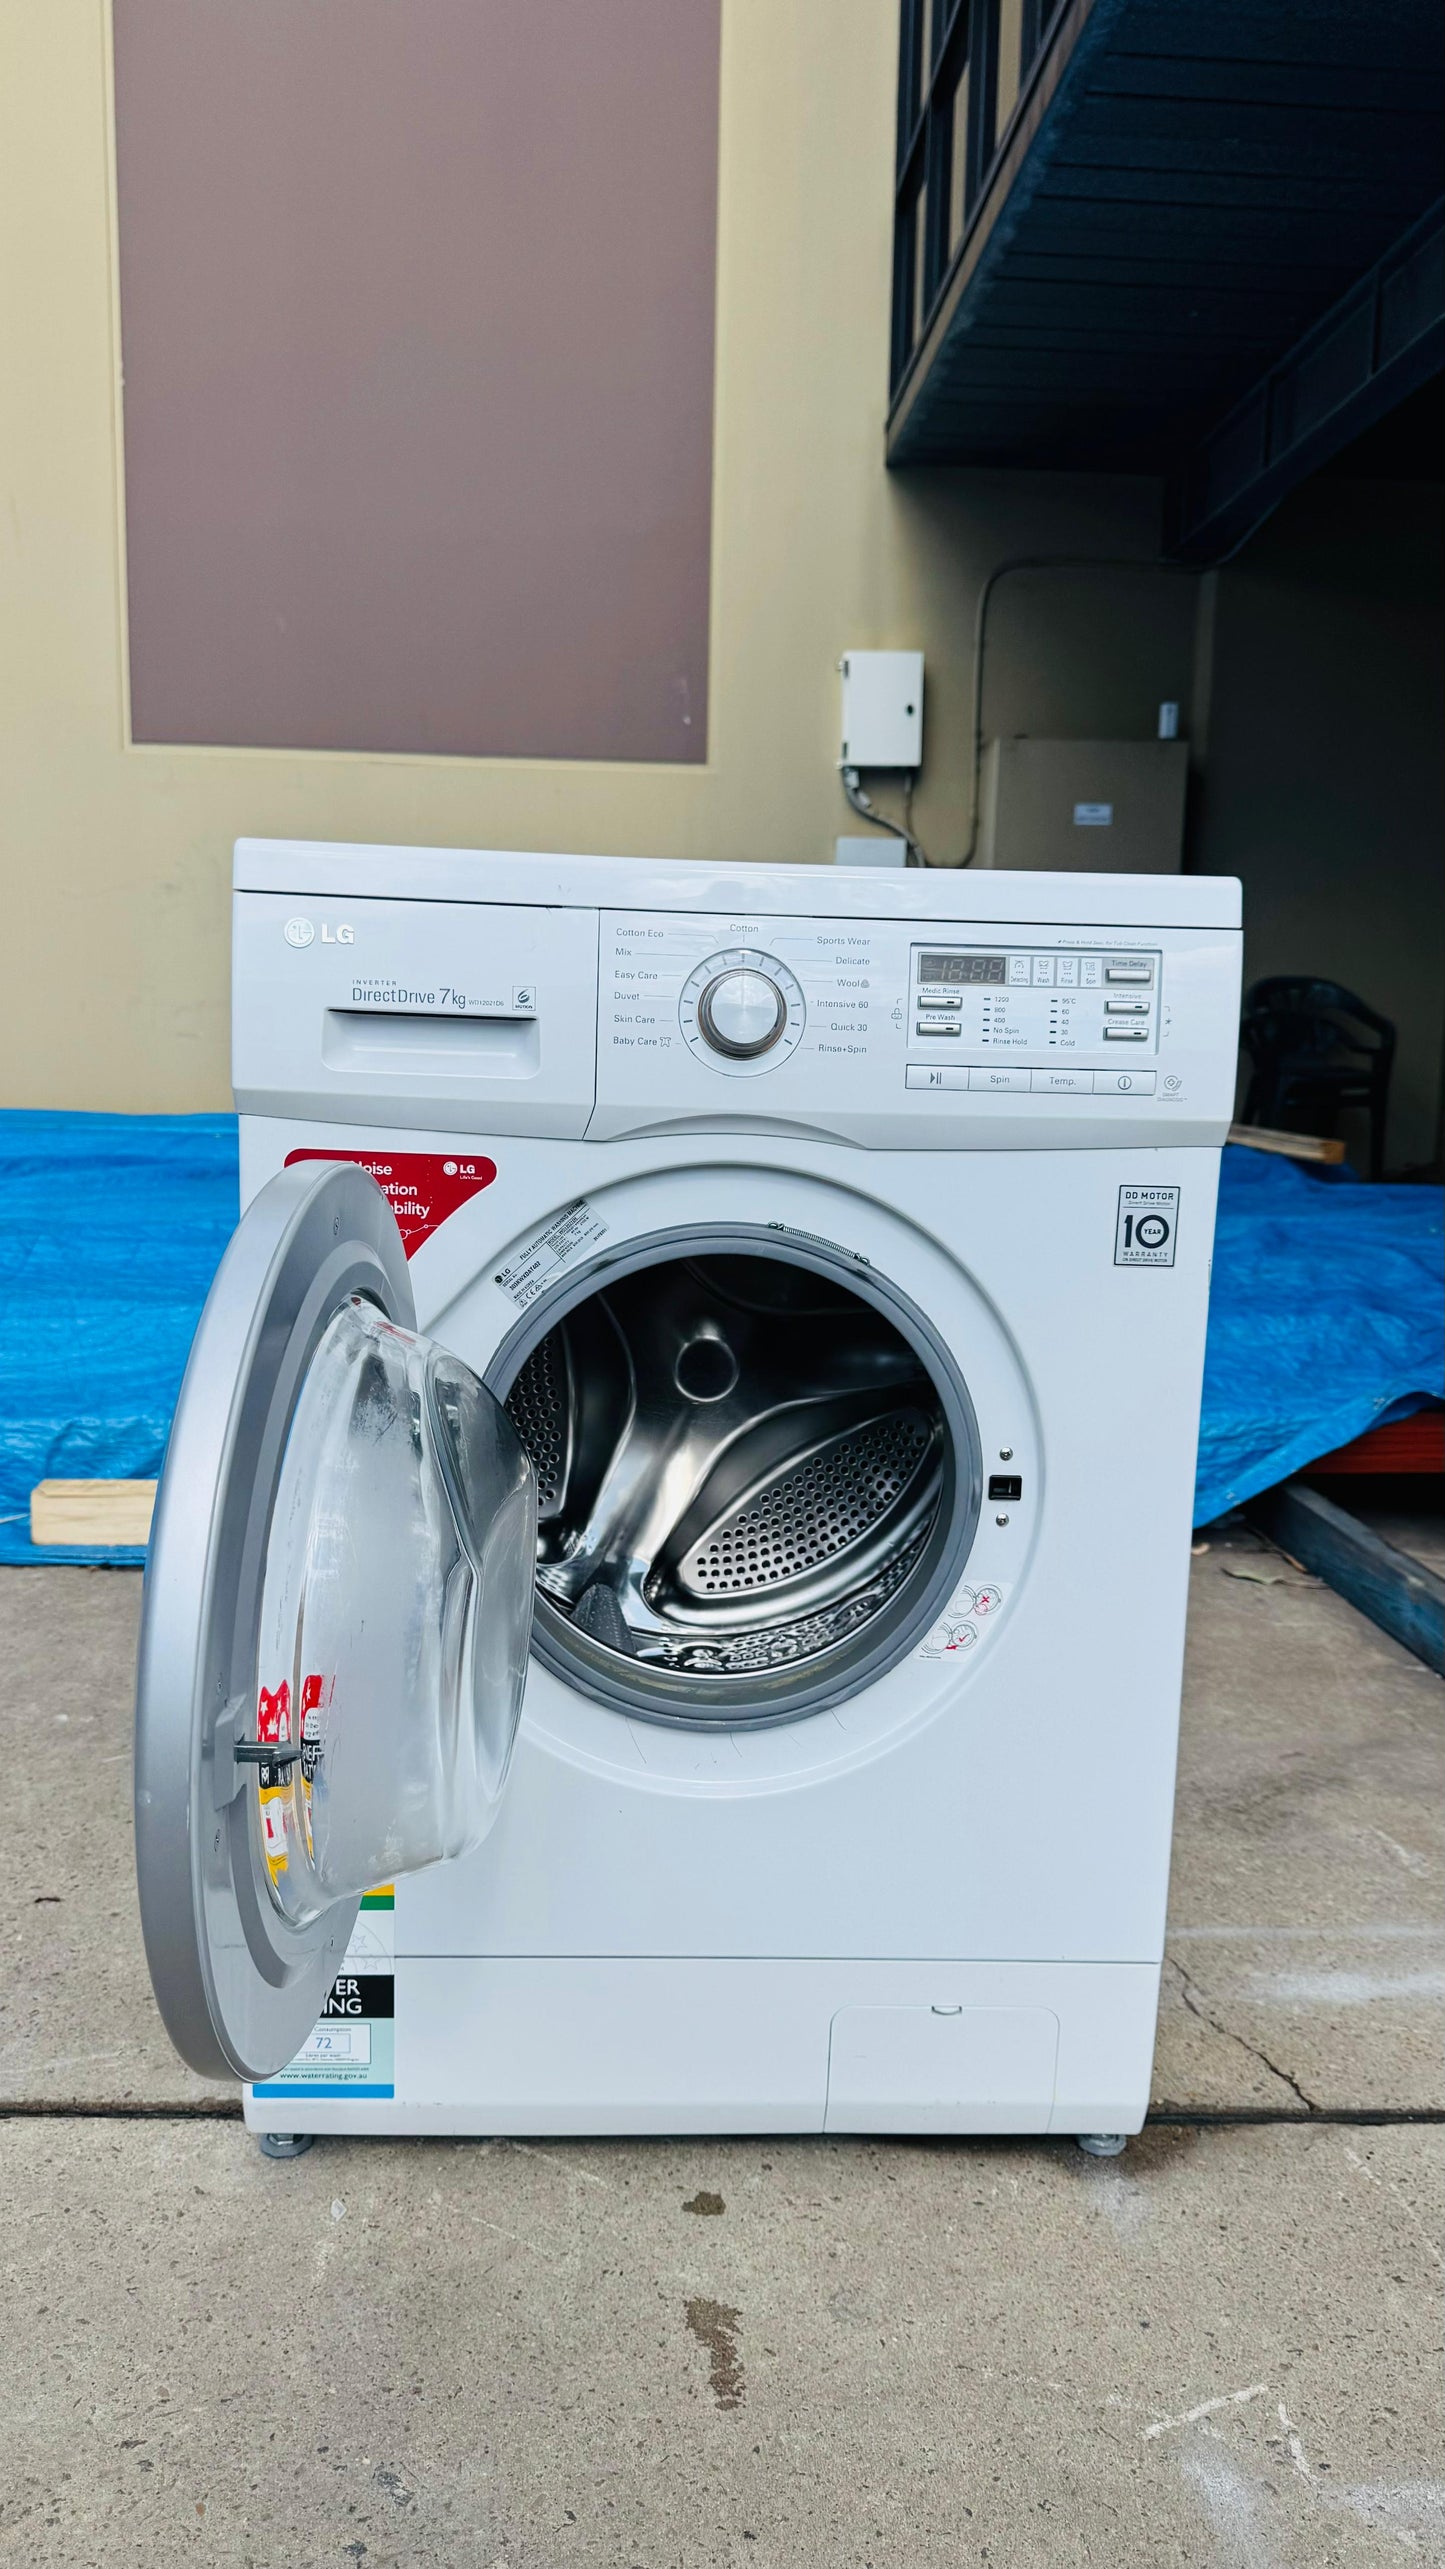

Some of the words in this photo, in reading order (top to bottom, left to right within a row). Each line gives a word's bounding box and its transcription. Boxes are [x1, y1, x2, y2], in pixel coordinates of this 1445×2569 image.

[616, 928, 645, 937] Cotton
[648, 929, 664, 938] Eco
[730, 923, 759, 933] Cotton
[321, 923, 355, 945] LG
[817, 936, 845, 946] Sports
[848, 937, 871, 946] Wear
[615, 948, 632, 956] Mix
[835, 956, 870, 965] Delicate
[614, 970, 635, 979] Easy
[638, 971, 658, 980] Care
[837, 978, 860, 987] Wool
[614, 991, 640, 1000] Duvet
[817, 1000, 856, 1009] Intensive
[858, 1001, 869, 1009] 60
[614, 1014, 633, 1023] Skin
[635, 1015, 655, 1024] Care
[830, 1022, 855, 1032] Quick
[857, 1024, 868, 1032] 30
[613, 1036, 635, 1046] Baby
[637, 1037, 658, 1046] Care
[1012, 1038, 1028, 1046] Hold
[818, 1043, 867, 1054] Rinse+Spin
[990, 1075, 1010, 1085] Spin
[1049, 1076, 1077, 1086] Temp.
[359, 1161, 393, 1176] oise
[459, 1164, 476, 1174] LG
[381, 1182, 418, 1196] ation
[1125, 1191, 1138, 1199] DD
[1140, 1192, 1174, 1200] MOTOR
[391, 1201, 430, 1219] bility
[1124, 1214, 1169, 1249] 10
[335, 1979, 361, 1995] ER
[323, 1998, 362, 2014] ING
[315, 2036, 332, 2049] 72
